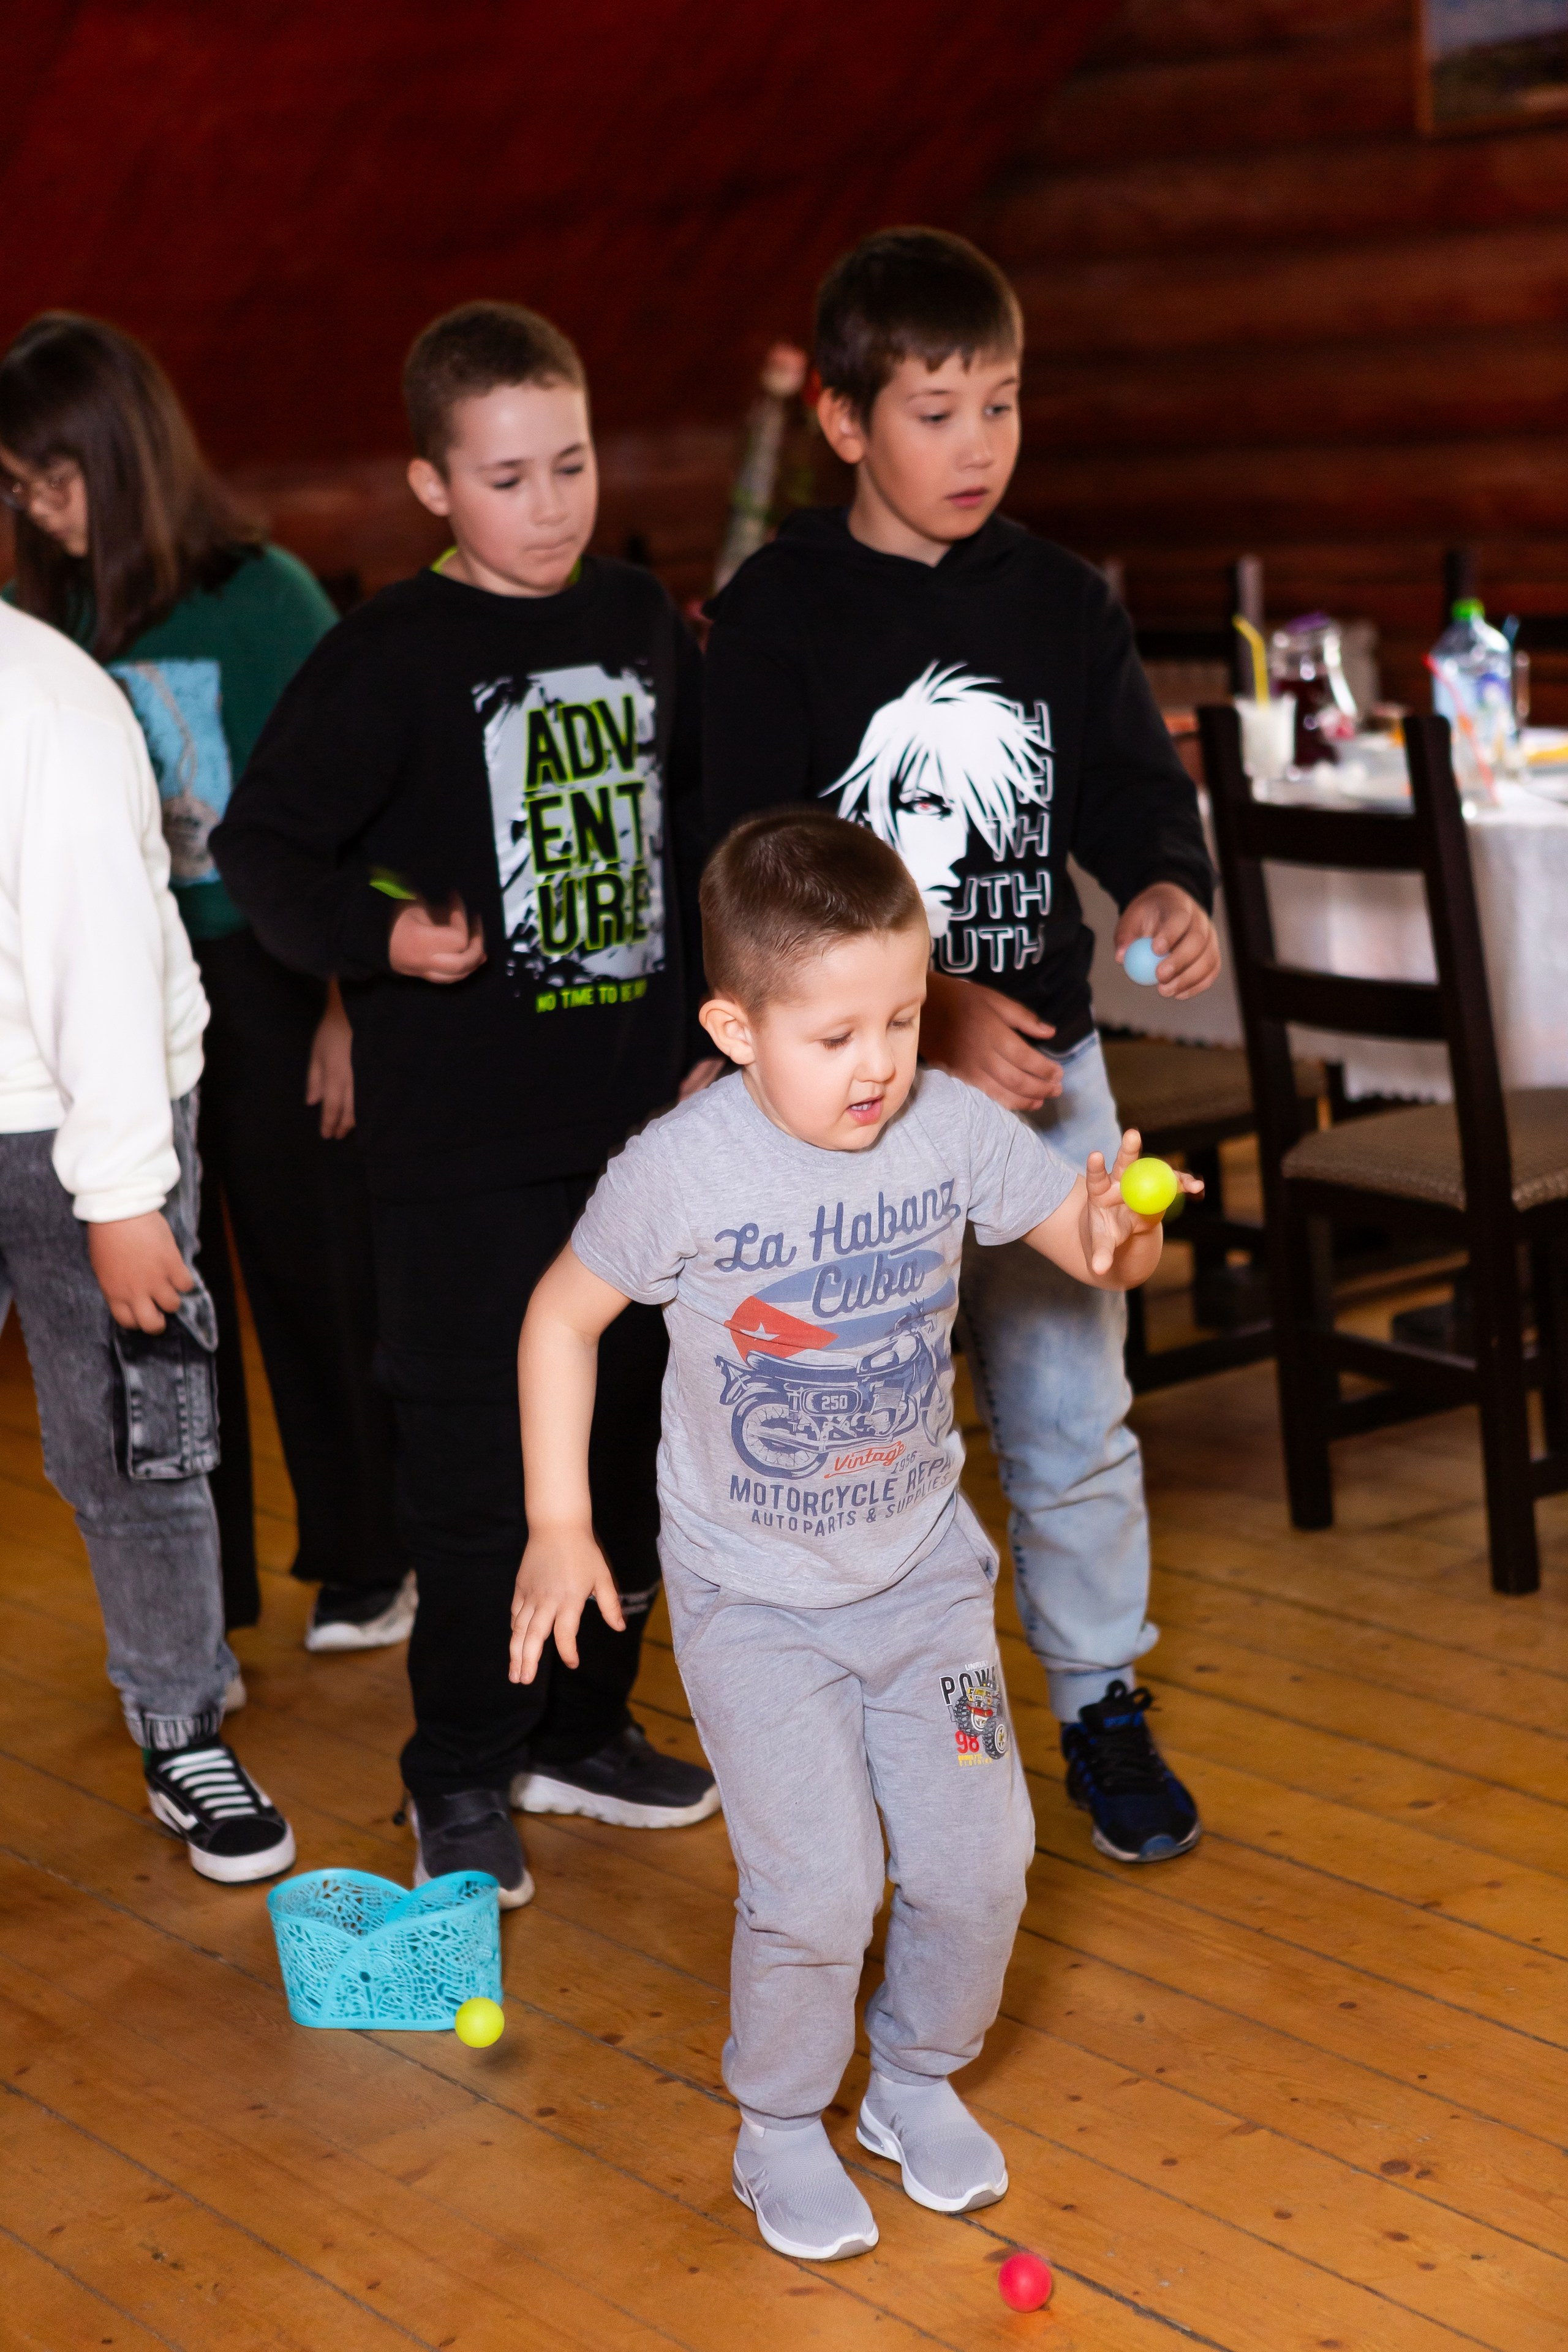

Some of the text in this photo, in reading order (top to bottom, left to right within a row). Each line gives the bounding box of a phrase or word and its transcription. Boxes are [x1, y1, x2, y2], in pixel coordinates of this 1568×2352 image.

[525, 694, 638, 794] ADV
[525, 782, 646, 875] ENT
[537, 865, 649, 957] URE
[931, 924, 1045, 974] UTH
[714, 1223, 797, 1273] La
[812, 1254, 925, 1319] Cuba
[821, 1395, 848, 1410] 250
[729, 1454, 953, 1517] MOTORCYCLE REPA
[865, 1508, 876, 1523] &
[885, 1472, 951, 1518] SUPPLIES
[939, 1665, 995, 1706] POW
[954, 1730, 980, 1754] 98
